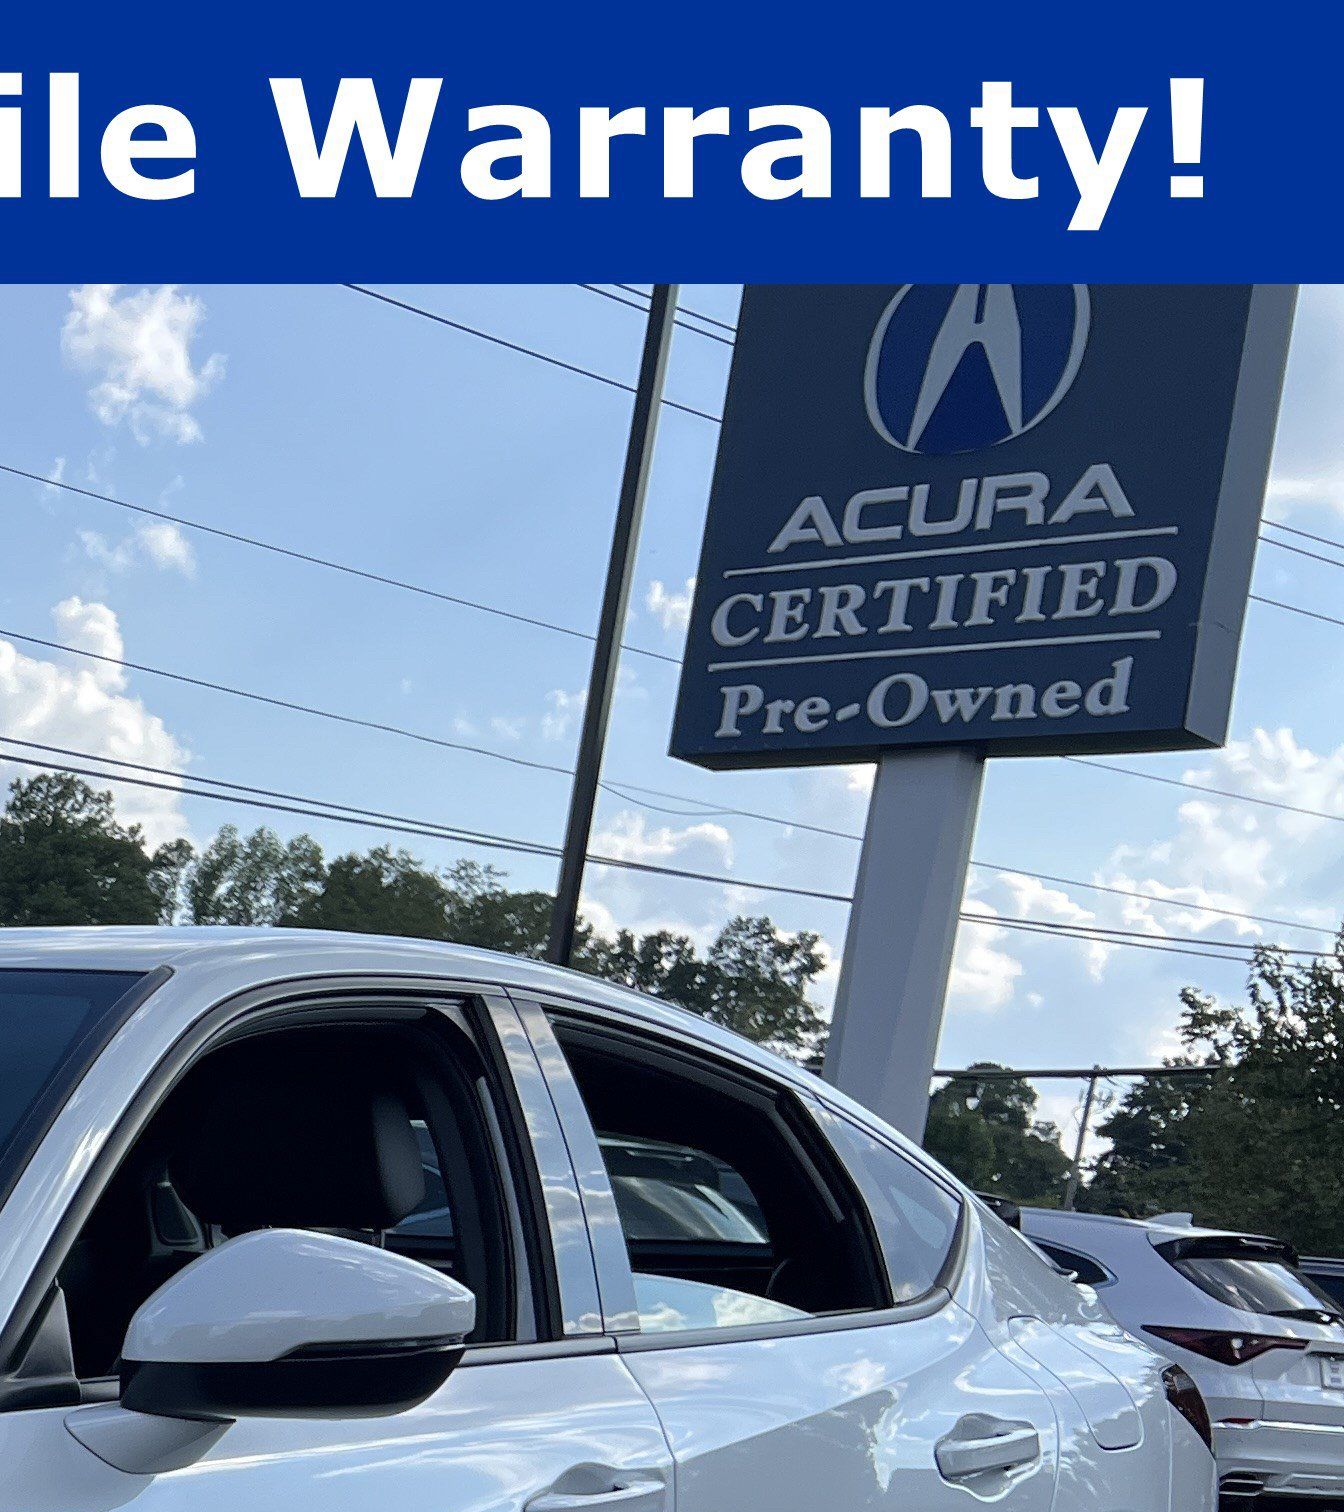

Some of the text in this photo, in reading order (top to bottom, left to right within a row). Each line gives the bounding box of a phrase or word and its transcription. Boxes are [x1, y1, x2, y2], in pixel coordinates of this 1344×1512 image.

[767, 463, 1135, 553] ACURA
[712, 556, 1178, 647] CERTIFIED
[714, 656, 1134, 738] Pre-Owned
